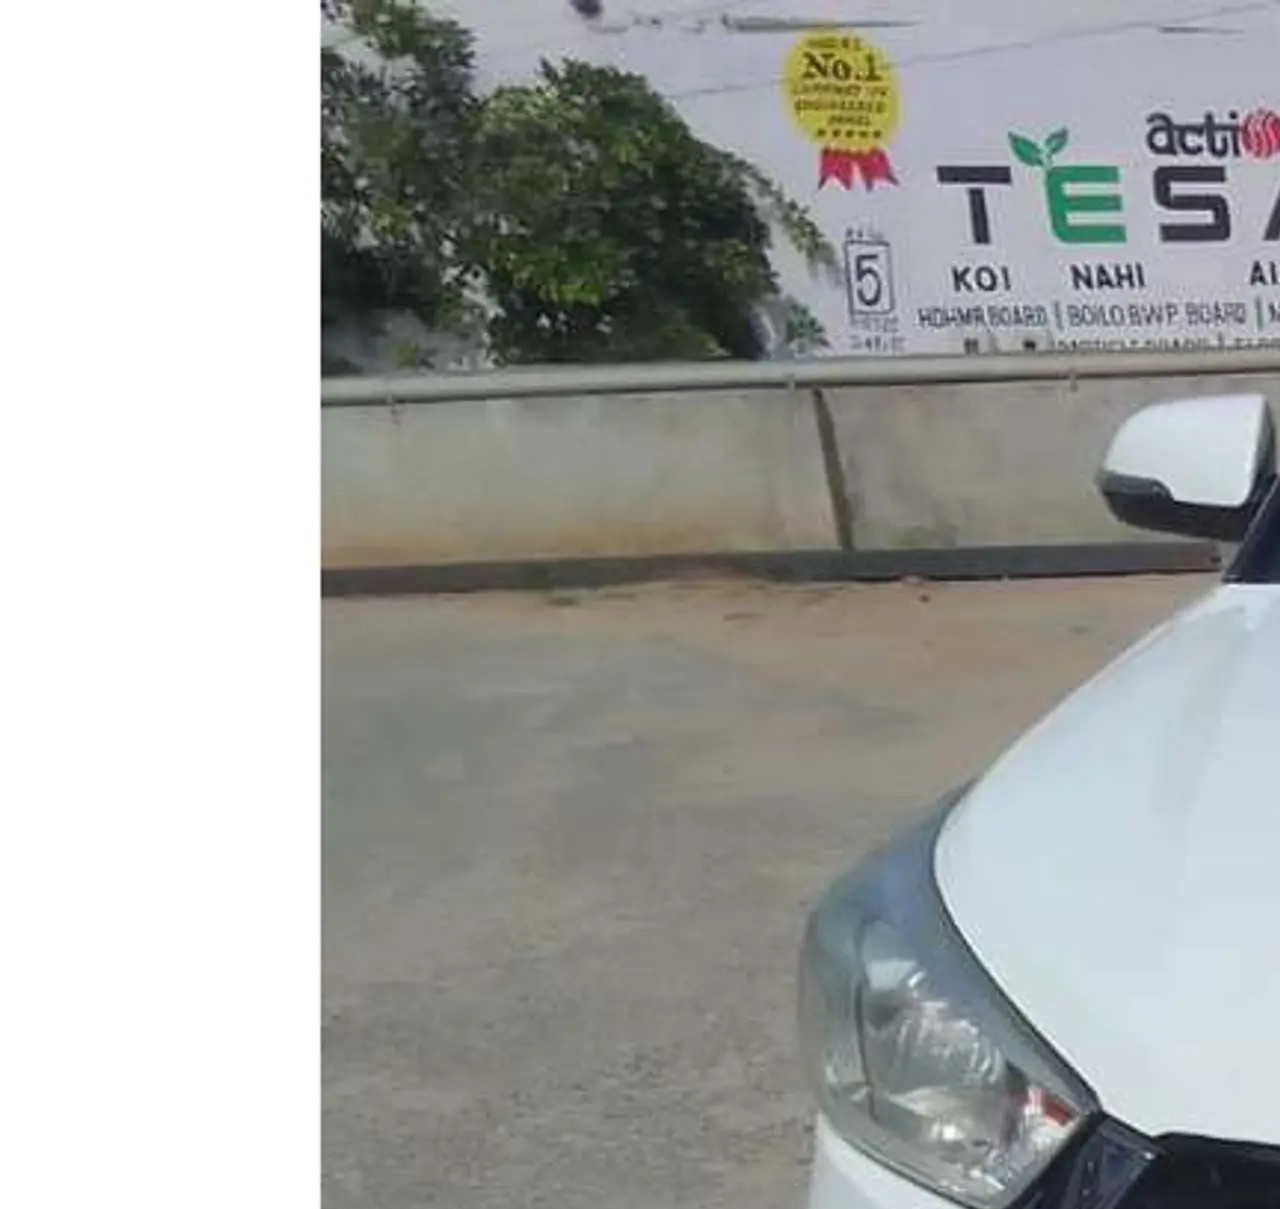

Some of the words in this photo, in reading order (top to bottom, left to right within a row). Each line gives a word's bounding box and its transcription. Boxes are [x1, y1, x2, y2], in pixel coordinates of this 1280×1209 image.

[801, 51, 884, 81] No.1
[856, 253, 882, 306] 5
[951, 265, 1012, 293] KOI
[1069, 262, 1147, 291] NAHI
[986, 304, 1048, 327] BOARD
[1184, 301, 1247, 326] BOARD
